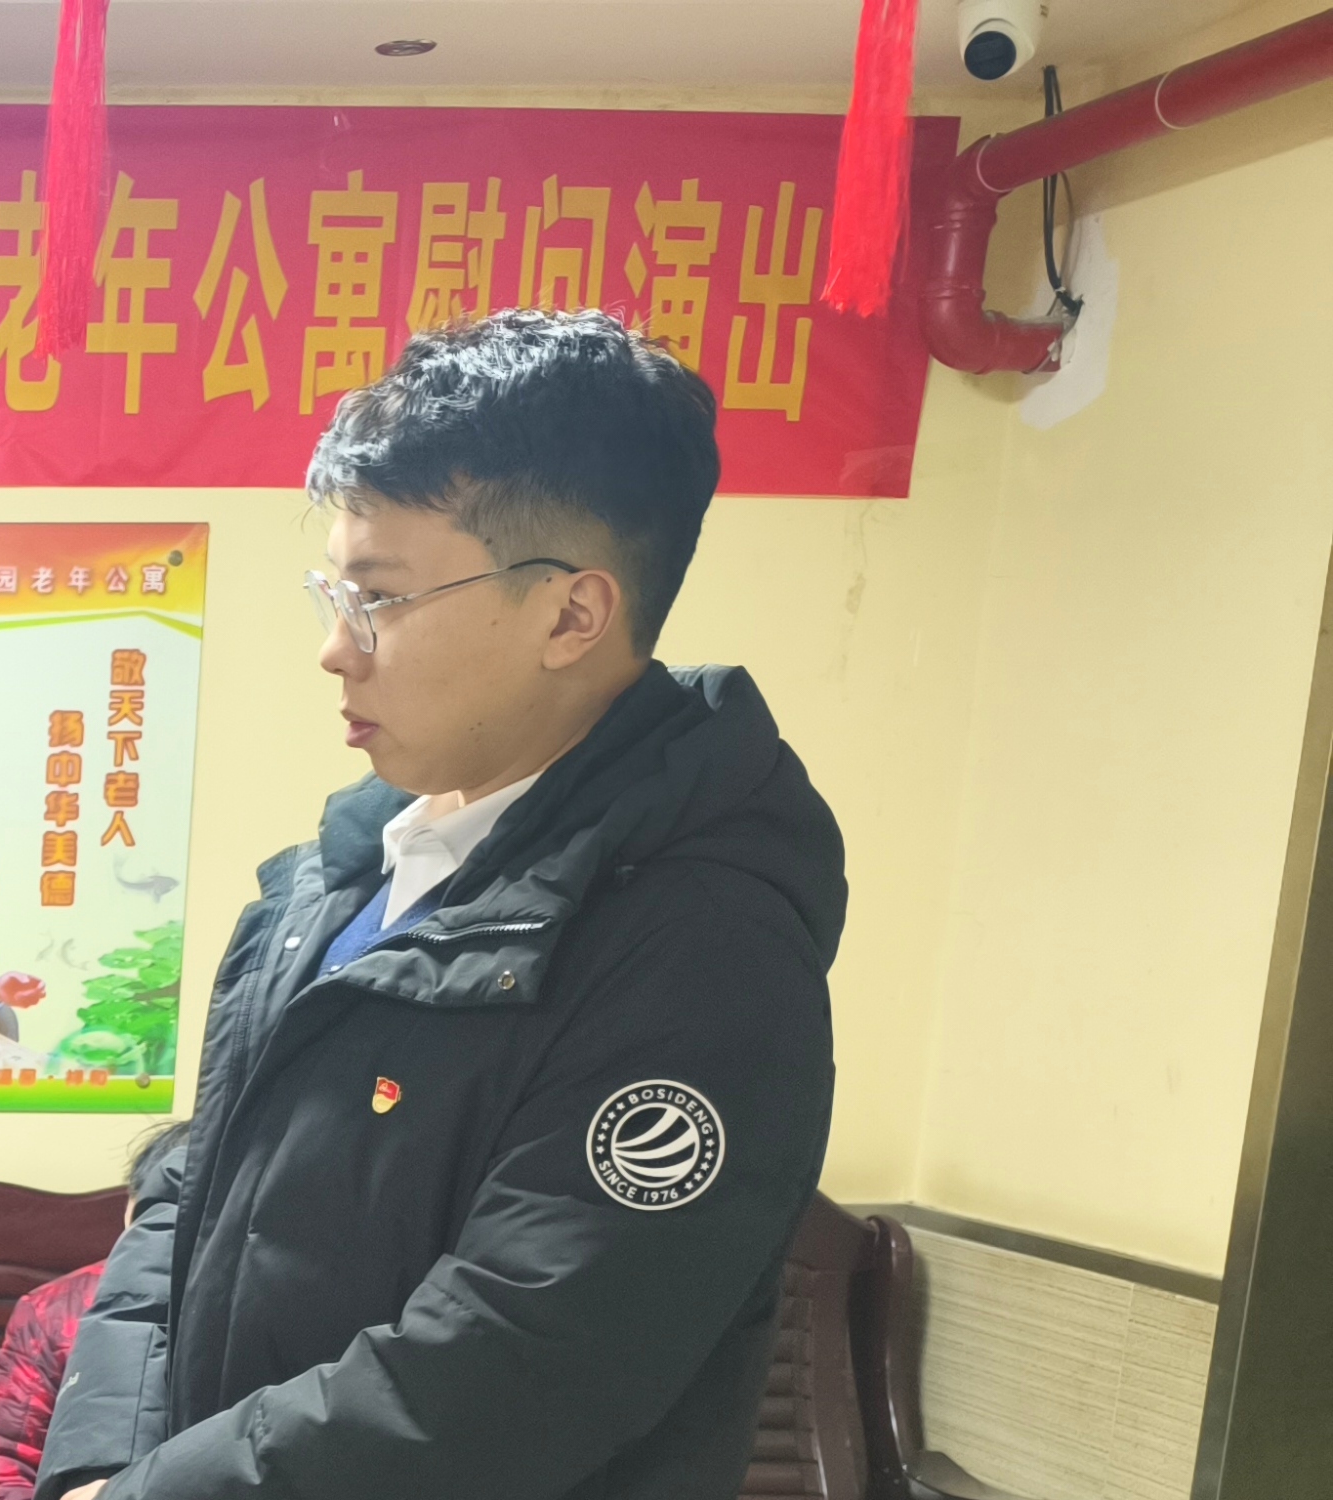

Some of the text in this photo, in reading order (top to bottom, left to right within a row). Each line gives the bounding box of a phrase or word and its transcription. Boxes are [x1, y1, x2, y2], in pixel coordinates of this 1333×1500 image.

[39, 709, 85, 907] 扬中华美德
[101, 648, 148, 847] 敬天下老人
[628, 1088, 715, 1136] BOSIDENG
[599, 1160, 679, 1203] SINCE 1976
